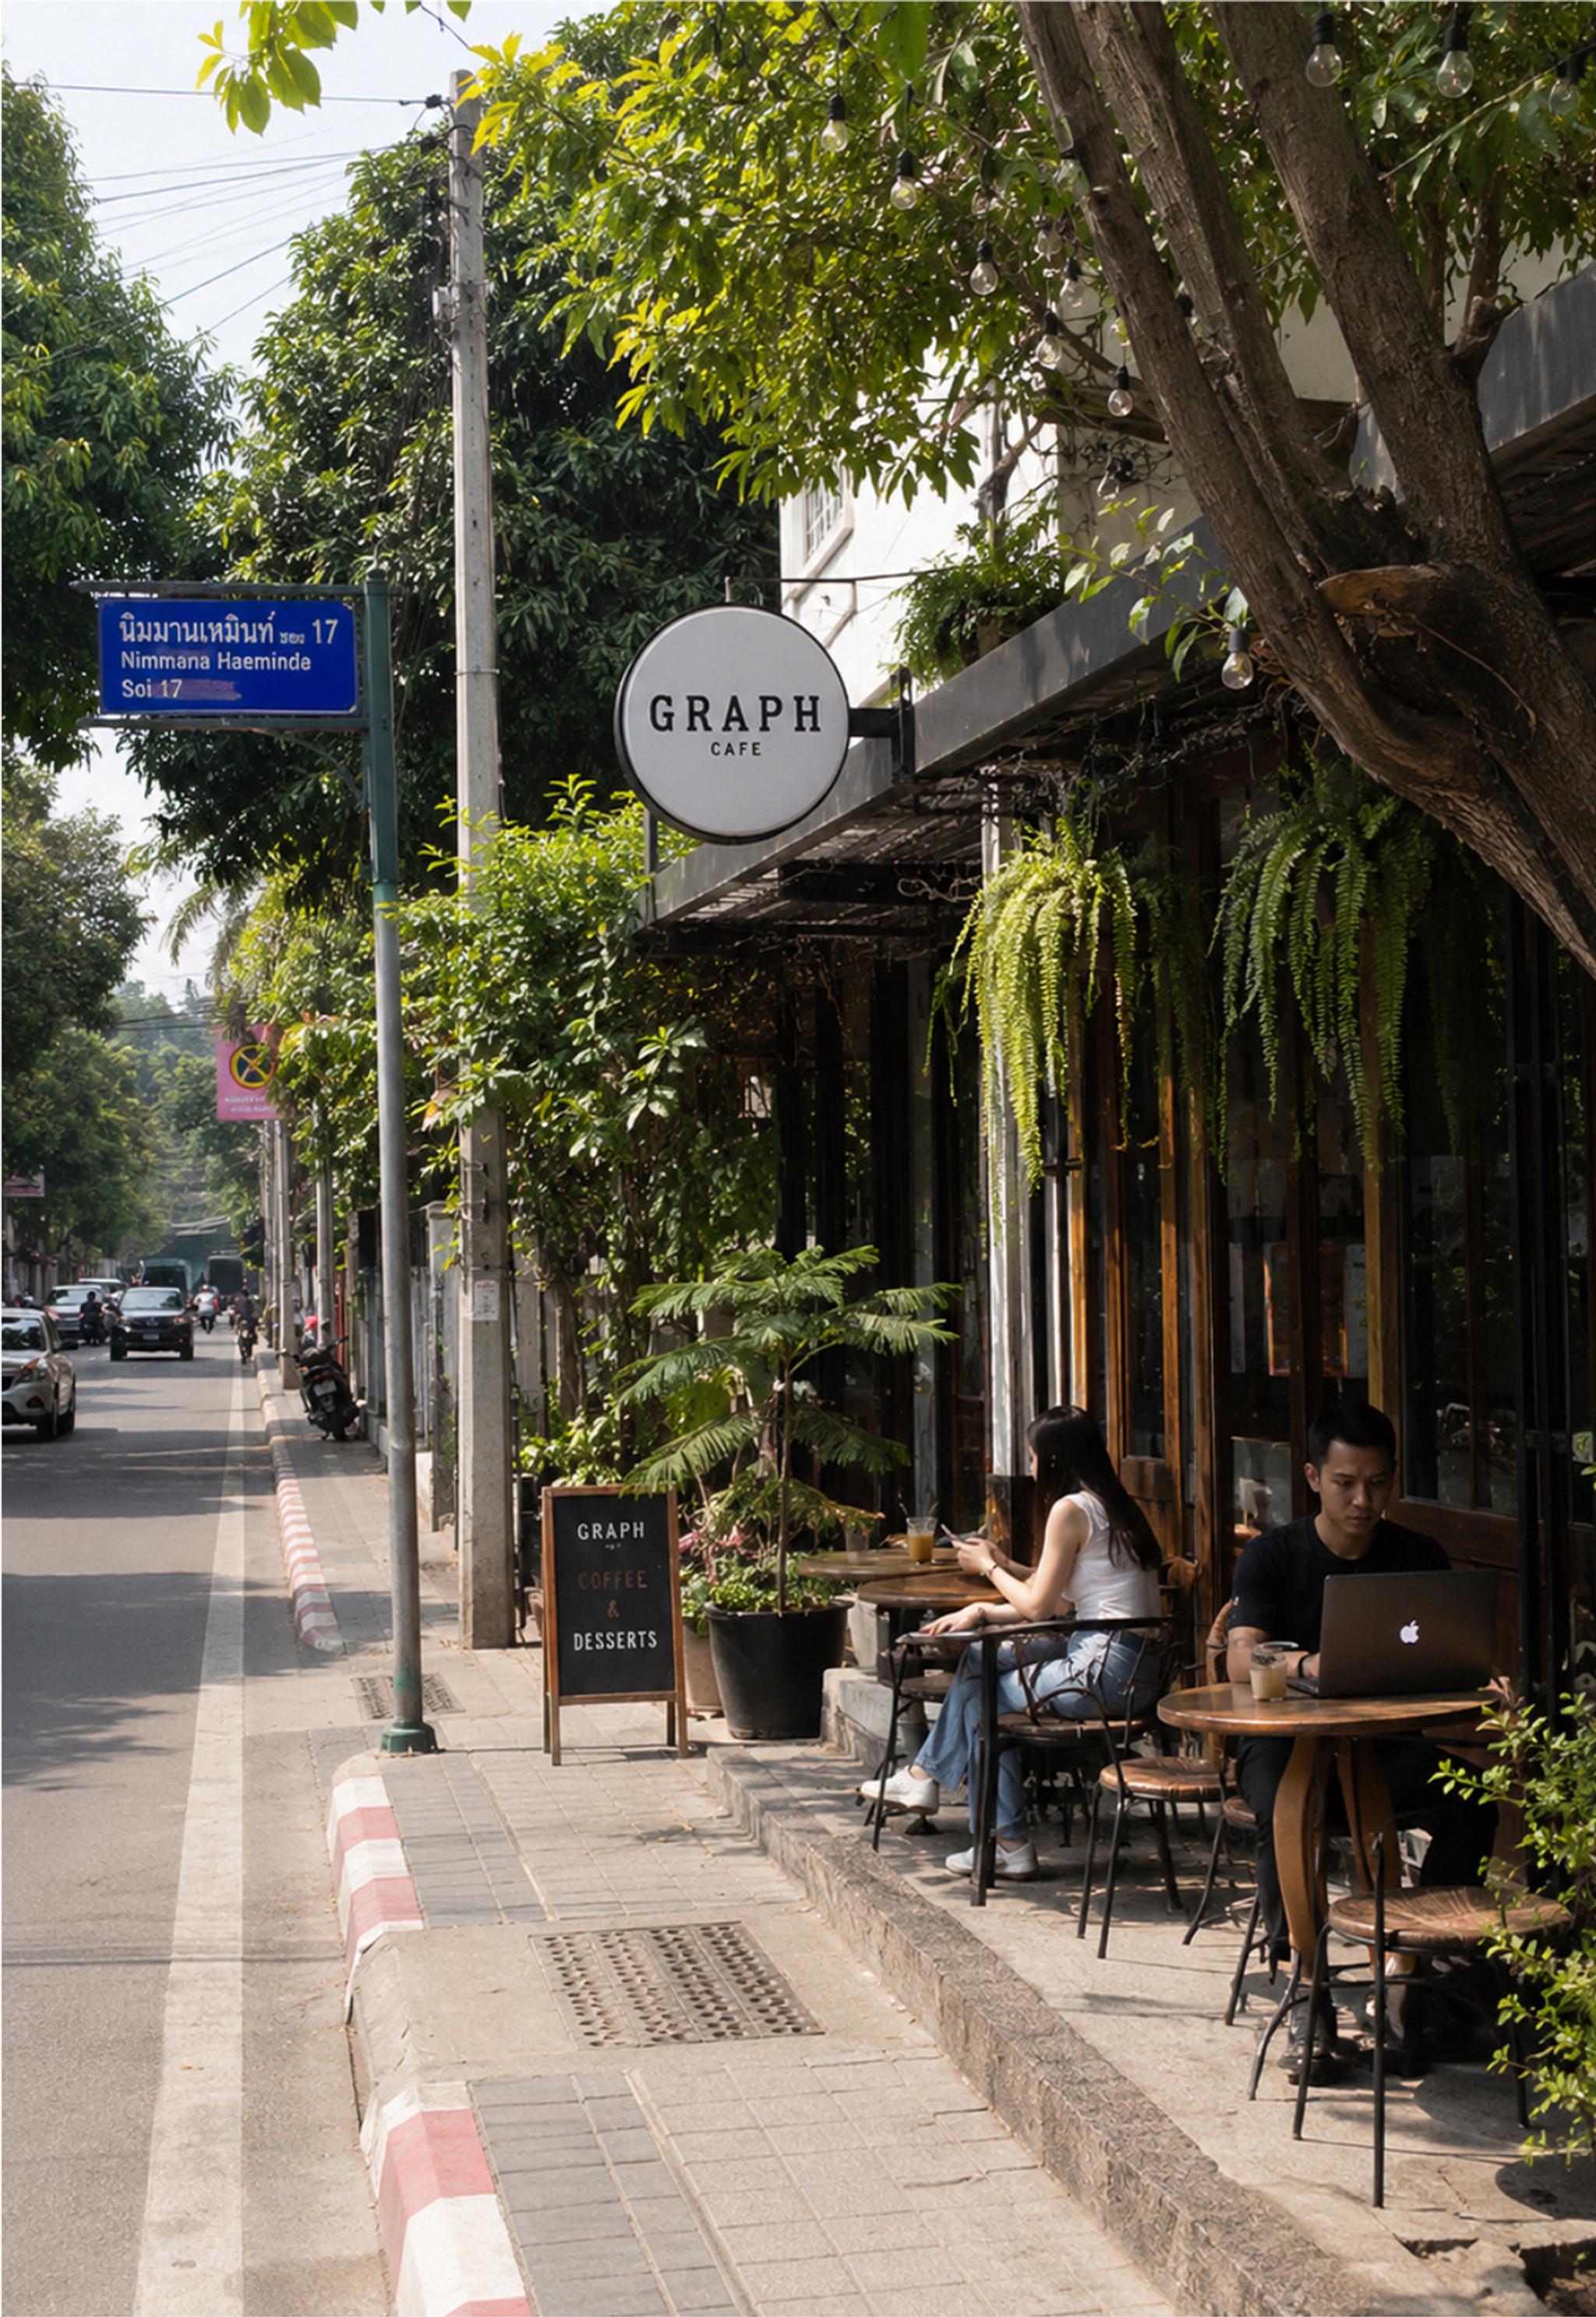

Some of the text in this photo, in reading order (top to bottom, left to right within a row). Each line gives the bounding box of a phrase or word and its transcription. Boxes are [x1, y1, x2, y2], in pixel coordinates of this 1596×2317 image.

[312, 619, 338, 645] 17
[121, 651, 210, 670] Nimmana
[122, 678, 183, 698] Soi 17
[649, 694, 821, 732] GRAPH
[711, 742, 761, 756] CAFE
[577, 1522, 644, 1540] GRAPH
[578, 1570, 648, 1590] COFFEE
[607, 1599, 620, 1618] &
[574, 1630, 657, 1651] DESSERTS
